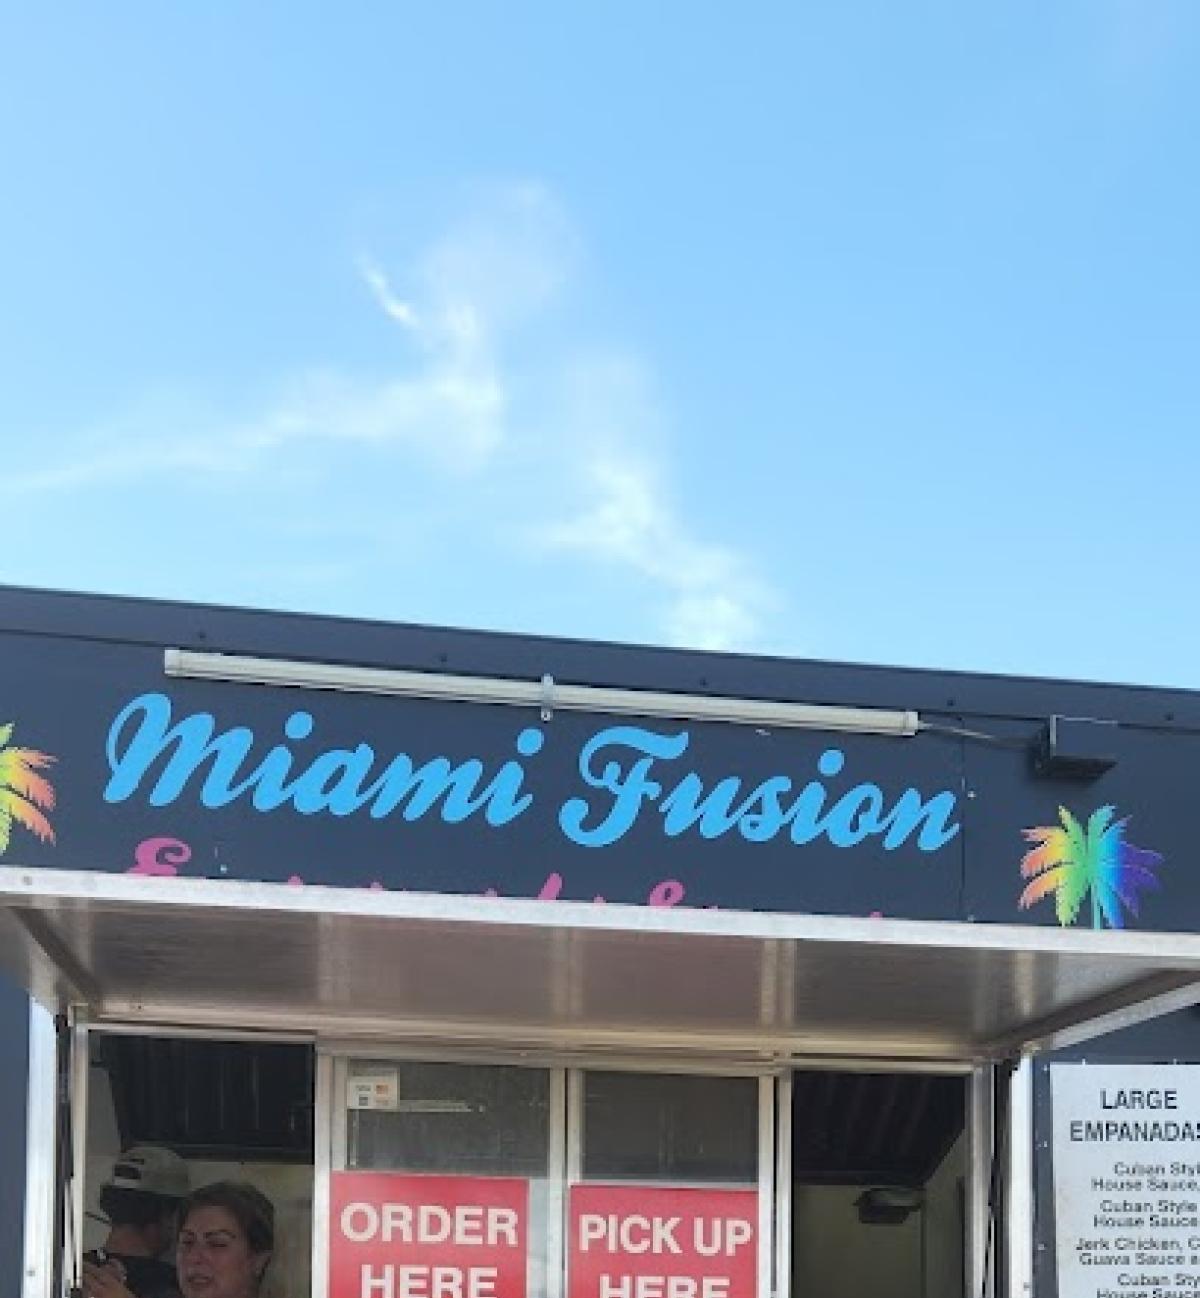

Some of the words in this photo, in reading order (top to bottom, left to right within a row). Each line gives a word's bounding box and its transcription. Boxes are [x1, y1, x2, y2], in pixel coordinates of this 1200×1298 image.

[102, 692, 545, 827] Miami
[559, 725, 960, 852] Fusion
[1100, 1088, 1177, 1110] LARGE
[1070, 1120, 1200, 1142] EMPANADA
[1113, 1160, 1166, 1176] Cuban
[1091, 1178, 1142, 1191] House
[1100, 1200, 1153, 1212] Cuban
[1158, 1199, 1198, 1215] Style
[340, 1202, 518, 1247] ORDER
[1093, 1214, 1145, 1227] House
[579, 1214, 683, 1255] PICK
[694, 1216, 753, 1257] UP
[1079, 1253, 1130, 1265] Guava
[1135, 1253, 1186, 1265] Sauce
[1117, 1273, 1170, 1286] Cuban
